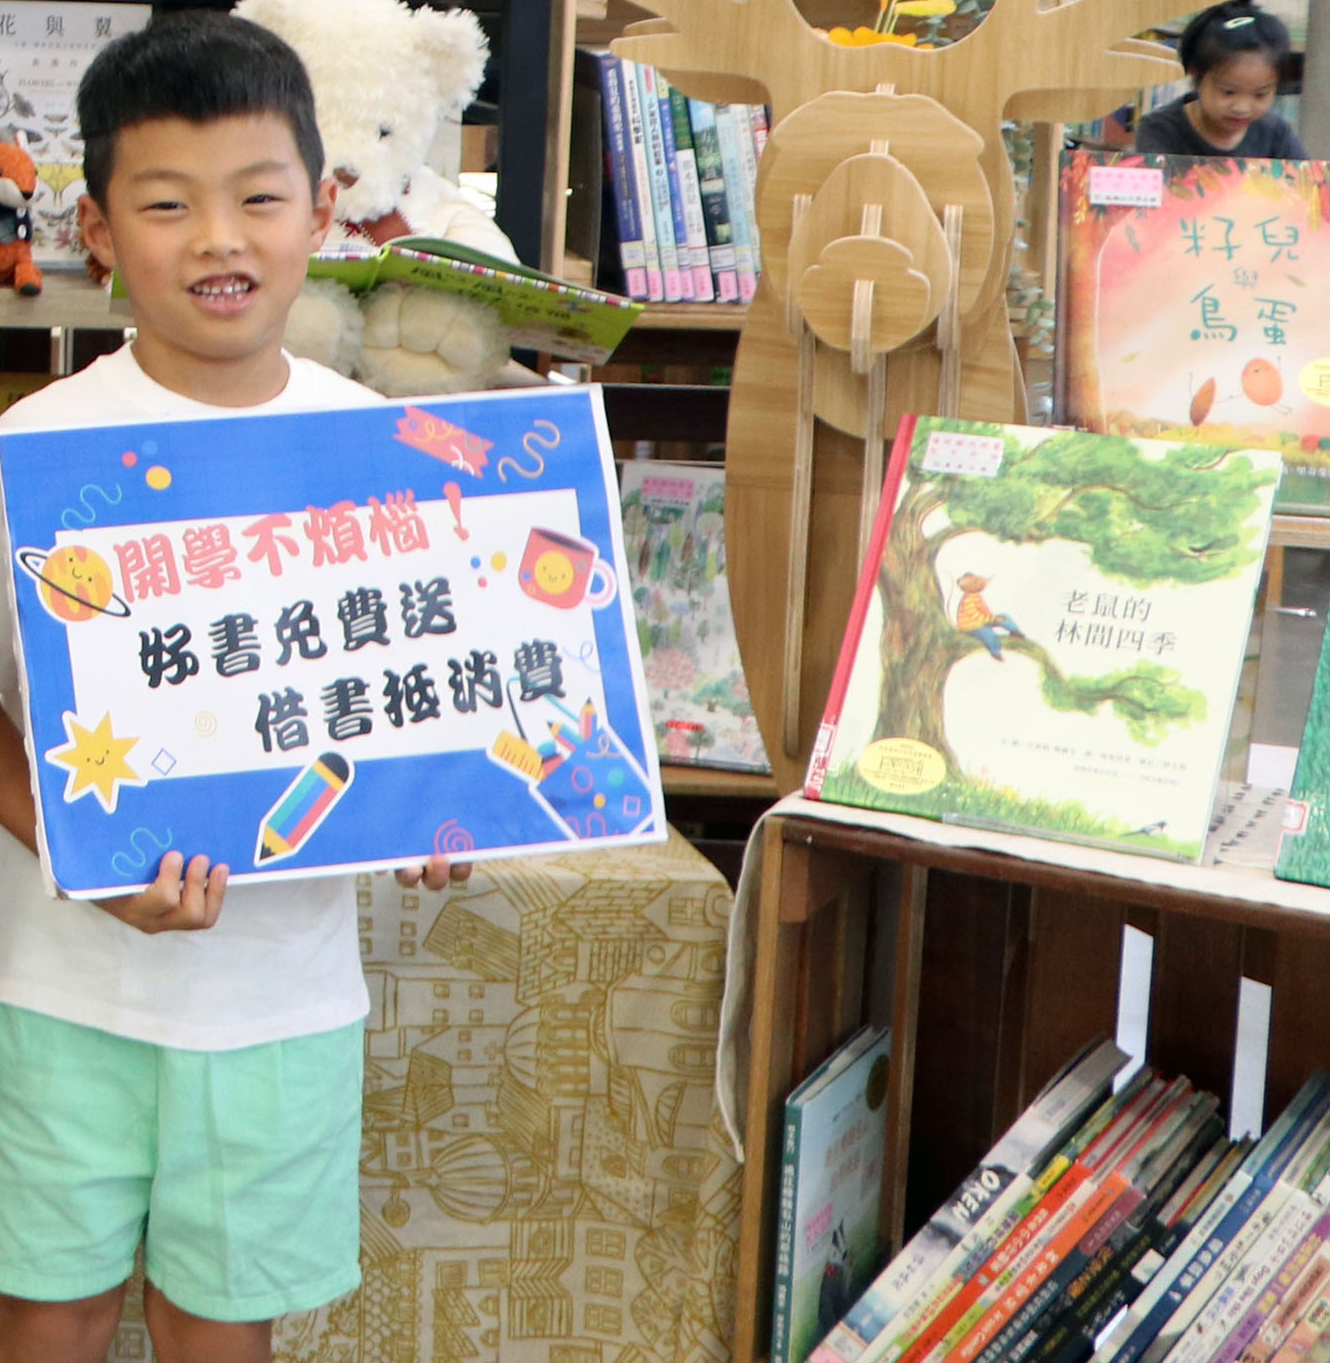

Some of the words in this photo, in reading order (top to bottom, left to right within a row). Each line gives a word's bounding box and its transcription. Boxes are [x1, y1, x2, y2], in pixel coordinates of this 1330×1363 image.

[1179, 214, 1300, 263] 籽兒
[1190, 283, 1298, 346] 鳥蛋
[112, 481, 471, 604] 開學不煩惱!
[138, 575, 458, 689] 好書免費送
[1054, 618, 1178, 656] 林間四季
[1065, 589, 1152, 622] 老鼠的
[253, 639, 567, 753] 借書抵消費
